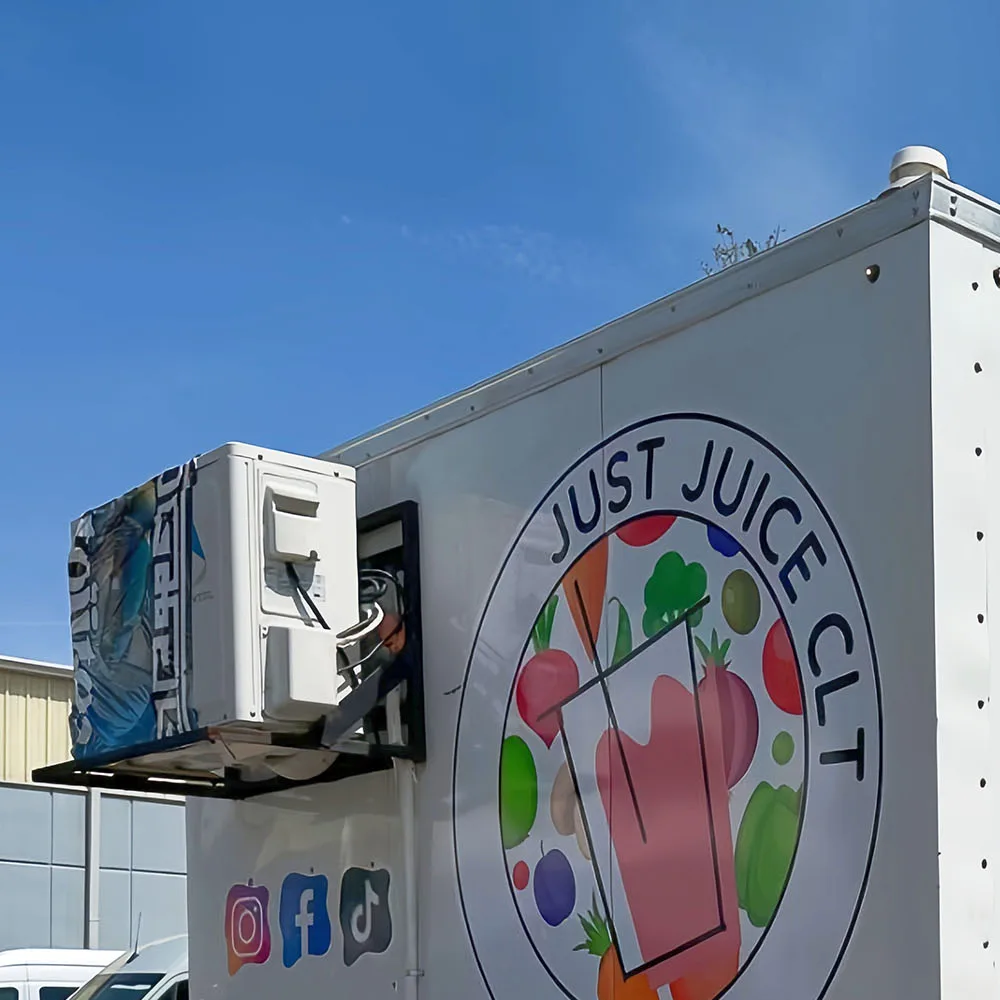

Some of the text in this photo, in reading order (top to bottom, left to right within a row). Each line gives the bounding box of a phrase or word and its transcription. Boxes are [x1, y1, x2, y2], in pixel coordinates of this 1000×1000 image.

[551, 436, 865, 781] JUST JUICE CLT
